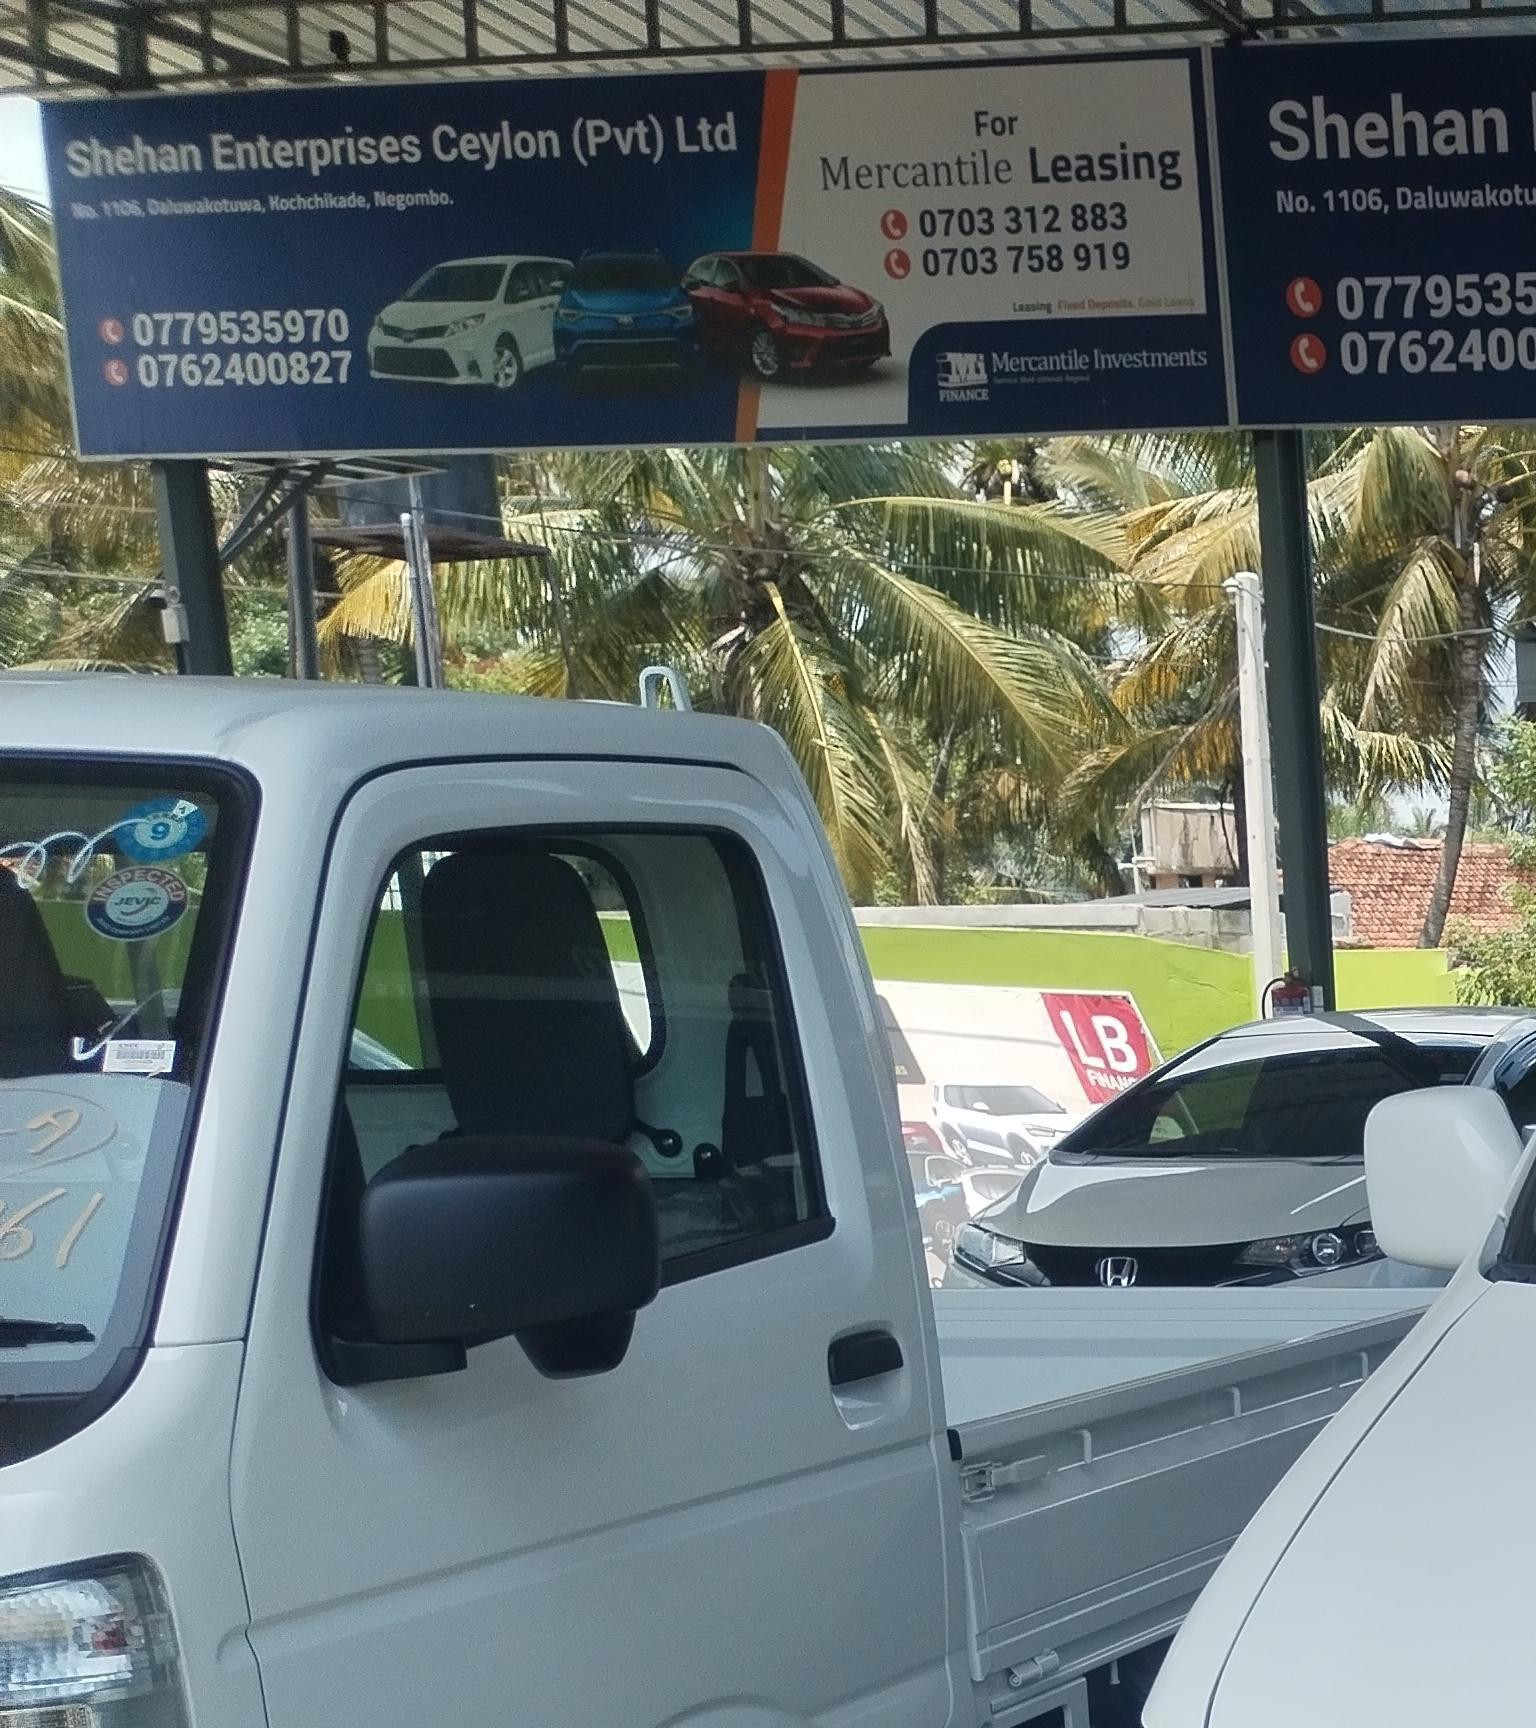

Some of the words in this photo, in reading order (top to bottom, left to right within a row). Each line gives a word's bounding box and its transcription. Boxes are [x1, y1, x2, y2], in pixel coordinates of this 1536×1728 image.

[973, 110, 1018, 137] For
[1268, 93, 1509, 161] Shehan
[66, 134, 202, 178] Shehan
[211, 127, 421, 176] Enterprises
[431, 120, 560, 171] Ceylon
[572, 114, 664, 166] (Pvt)
[675, 112, 738, 153] Ltd
[819, 150, 1012, 191] Mercantile
[1029, 141, 1183, 190] Leasing
[373, 189, 455, 212] Negombo.
[1276, 190, 1316, 213] No.
[1323, 188, 1389, 213] 1106,
[919, 206, 995, 238] 0703
[1005, 204, 1062, 235] 312
[1070, 201, 1128, 232] 883
[922, 246, 998, 277] 0703
[1007, 244, 1064, 274] 758
[1073, 241, 1130, 271] 919
[1012, 301, 1053, 314] Leasing
[133, 308, 349, 346] 0779535970
[138, 350, 352, 387] 0762400827
[991, 349, 1090, 373] Mercantile
[1094, 347, 1208, 370] Investments
[939, 387, 990, 402] FINANCE
[92, 869, 186, 902] INSPECTED
[1060, 1009, 1138, 1073] LB
